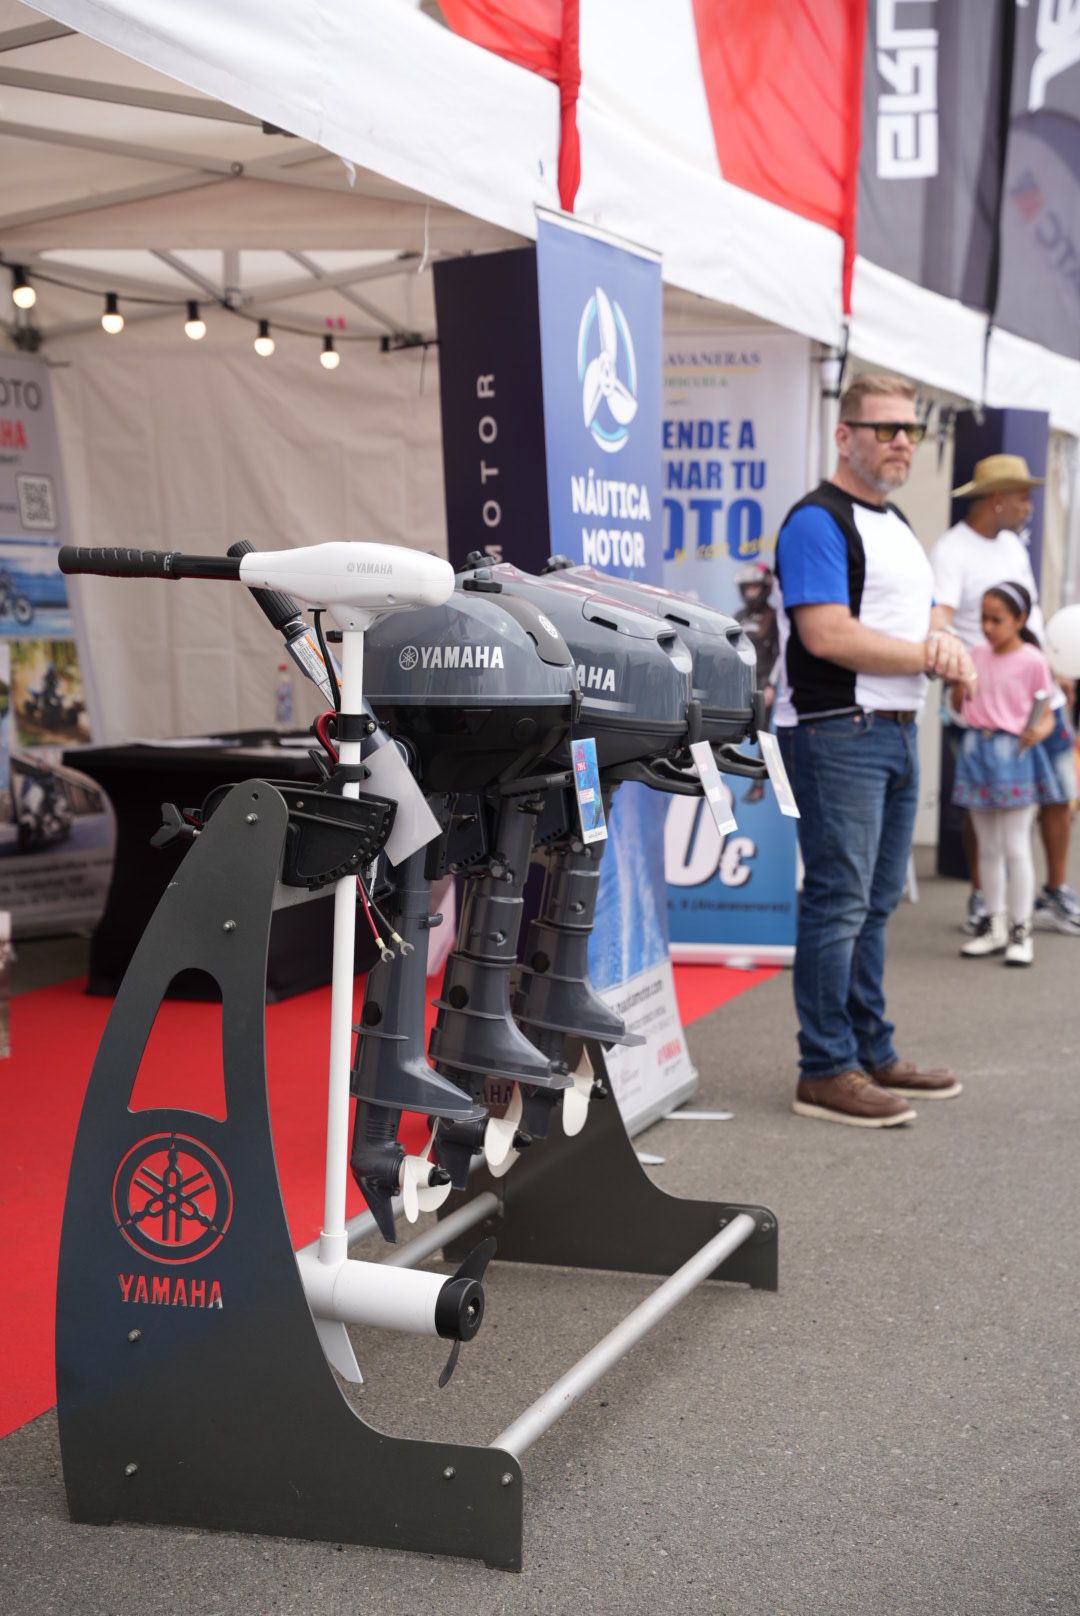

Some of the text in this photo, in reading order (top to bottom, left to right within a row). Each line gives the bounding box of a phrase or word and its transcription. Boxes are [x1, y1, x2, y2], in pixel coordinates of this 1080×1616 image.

[663, 420, 755, 450] ENDE A
[732, 460, 766, 490] TU
[571, 467, 651, 521] NÁUTICA
[582, 528, 646, 568] MOTOR
[356, 561, 393, 575] YAMAHA
[421, 646, 504, 669] YAMAHA
[118, 1273, 224, 1310] YAMAHA
